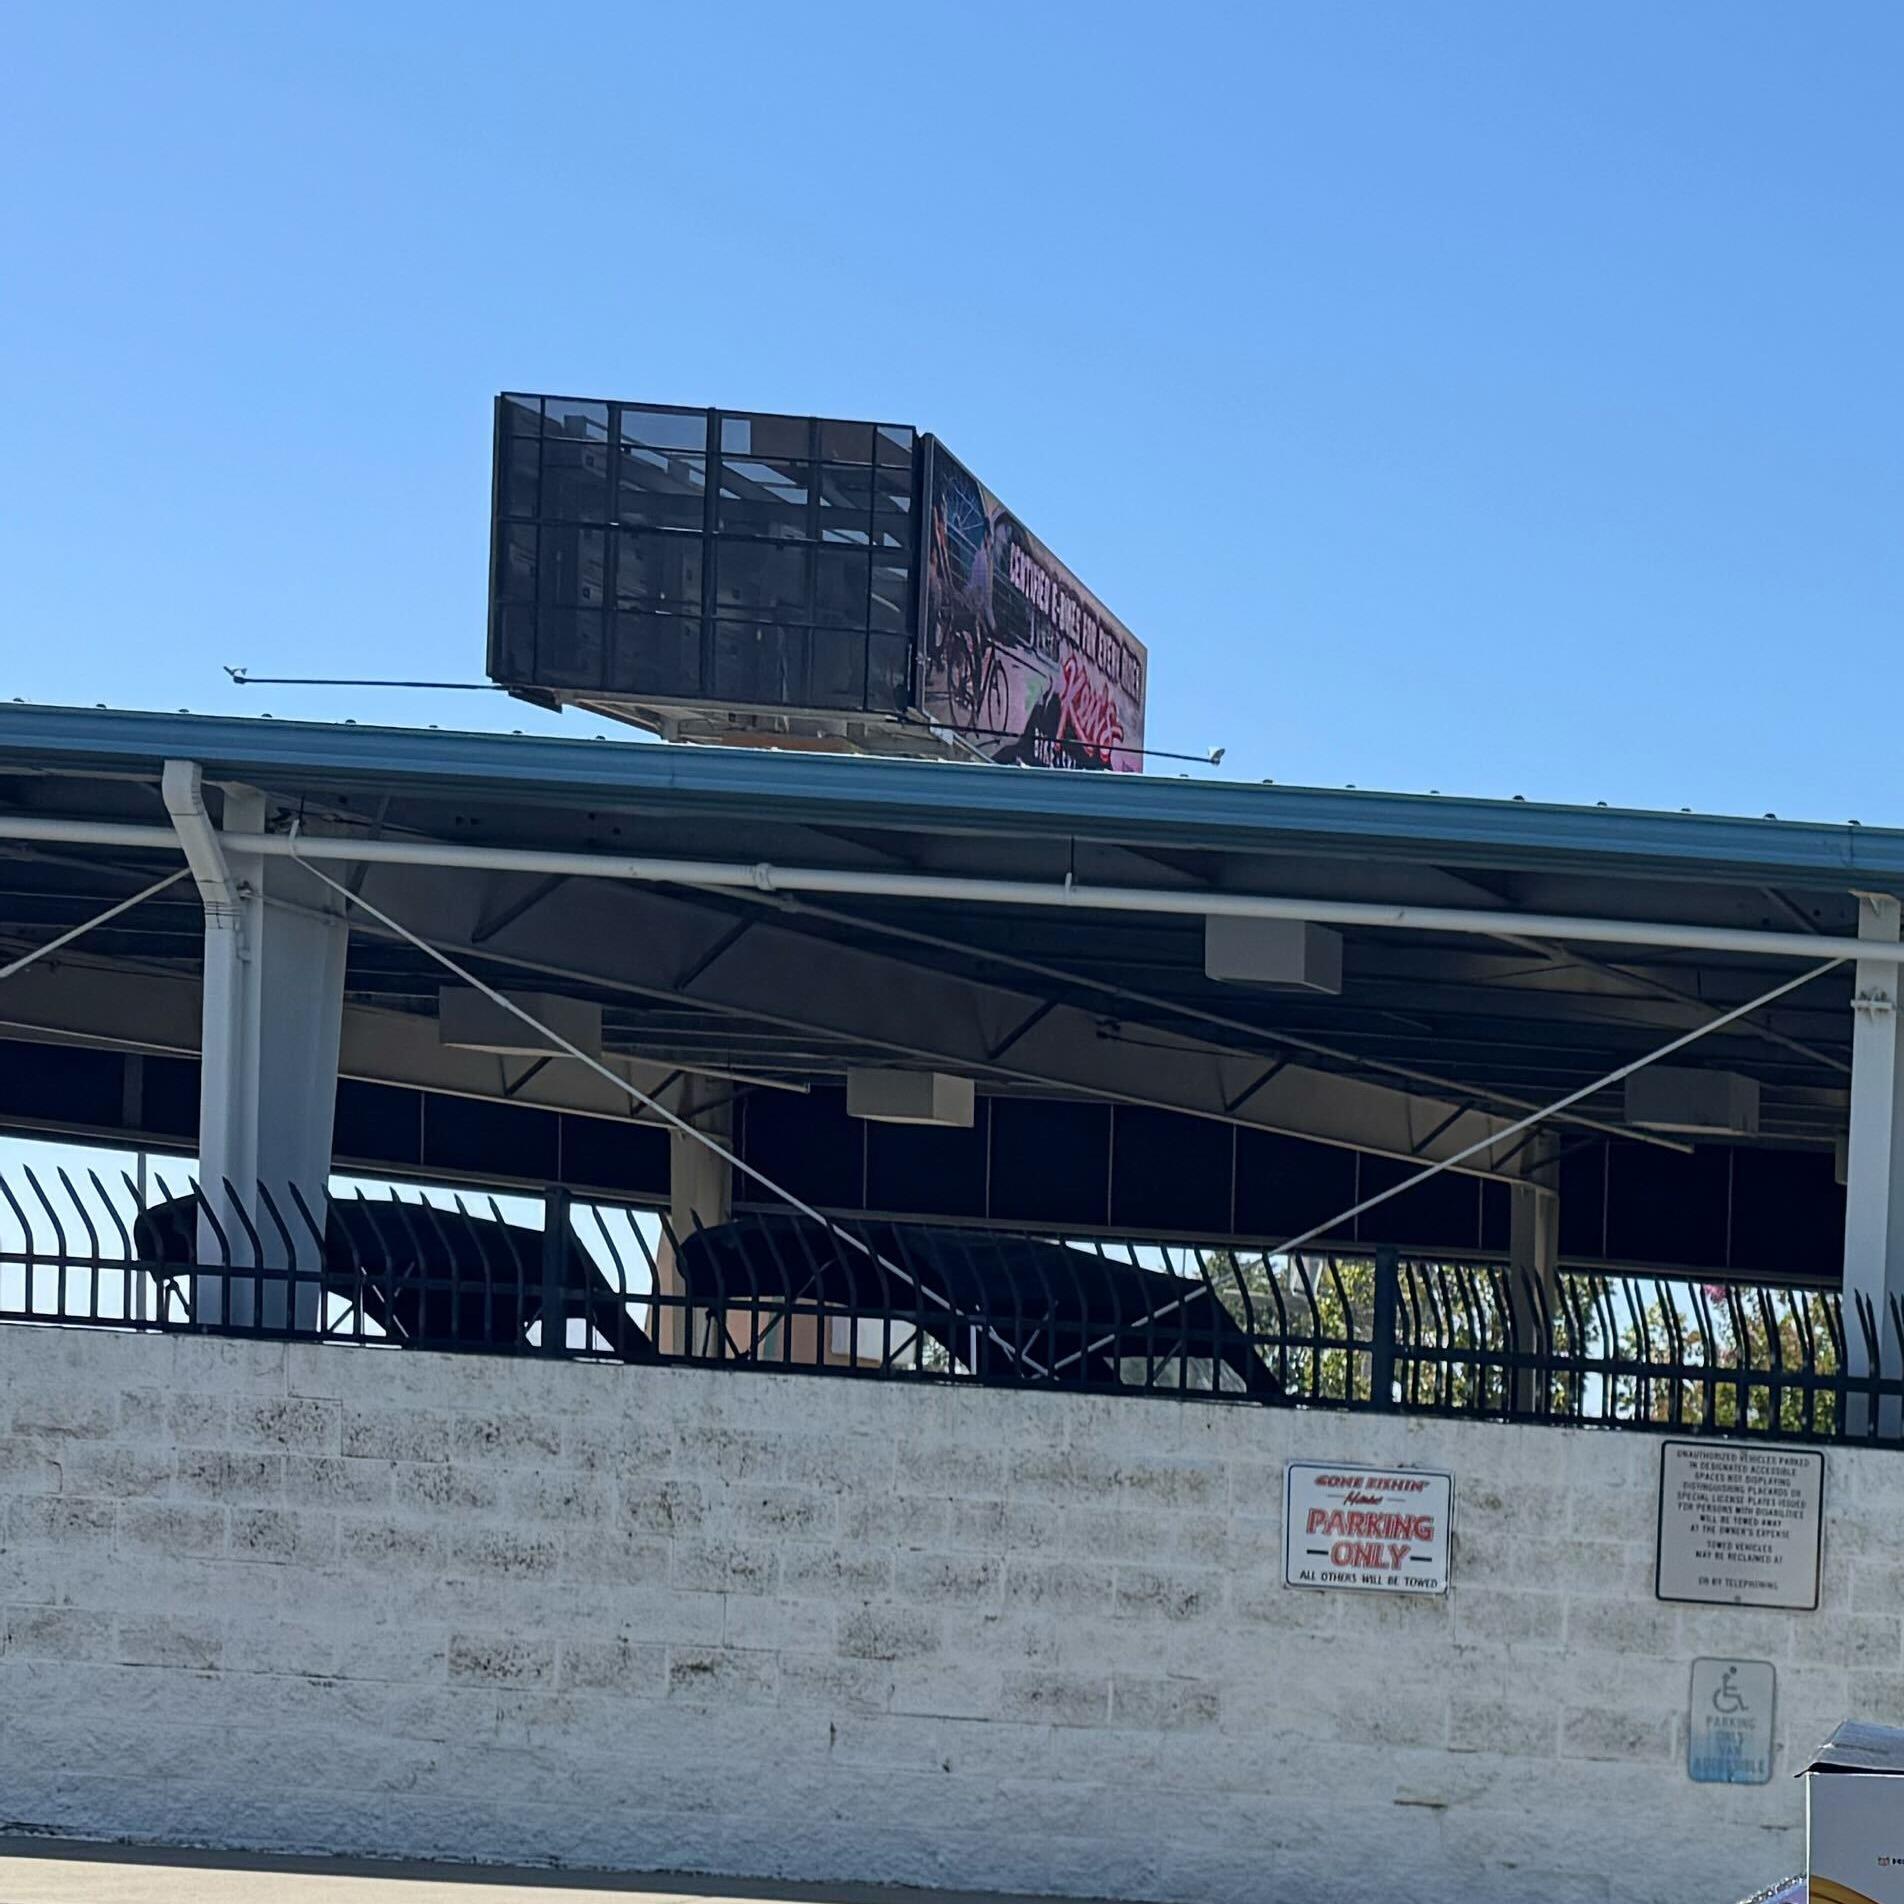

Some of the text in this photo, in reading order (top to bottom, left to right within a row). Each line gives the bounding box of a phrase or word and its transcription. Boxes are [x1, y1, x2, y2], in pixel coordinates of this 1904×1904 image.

[1779, 1456, 1809, 1467] PARKED
[1751, 1466, 1796, 1476] ACCESSIBLE
[1315, 1475, 1361, 1488] GONE
[1695, 1472, 1725, 1481] SPACES
[1745, 1476, 1790, 1487] DISPLAYING
[1748, 1486, 1788, 1496] PLACARDS
[1678, 1503, 1693, 1511] FOR
[1696, 1505, 1732, 1513] PERSONS
[1306, 1508, 1434, 1542] PARKING
[1700, 1515, 1717, 1523] WILL
[1720, 1516, 1730, 1524] BE
[1733, 1517, 1759, 1526] TOWED
[1703, 1526, 1715, 1534] THE
[1756, 1530, 1789, 1538] EXPENSE
[1707, 1540, 1772, 1553] TOWED VEHICLES
[1330, 1539, 1411, 1571] ONLY
[1696, 1551, 1711, 1559] MAY
[1728, 1554, 1771, 1564] RECLAIMED
[1300, 1570, 1438, 1588] ALL OTHERS WILL BE TOWED
